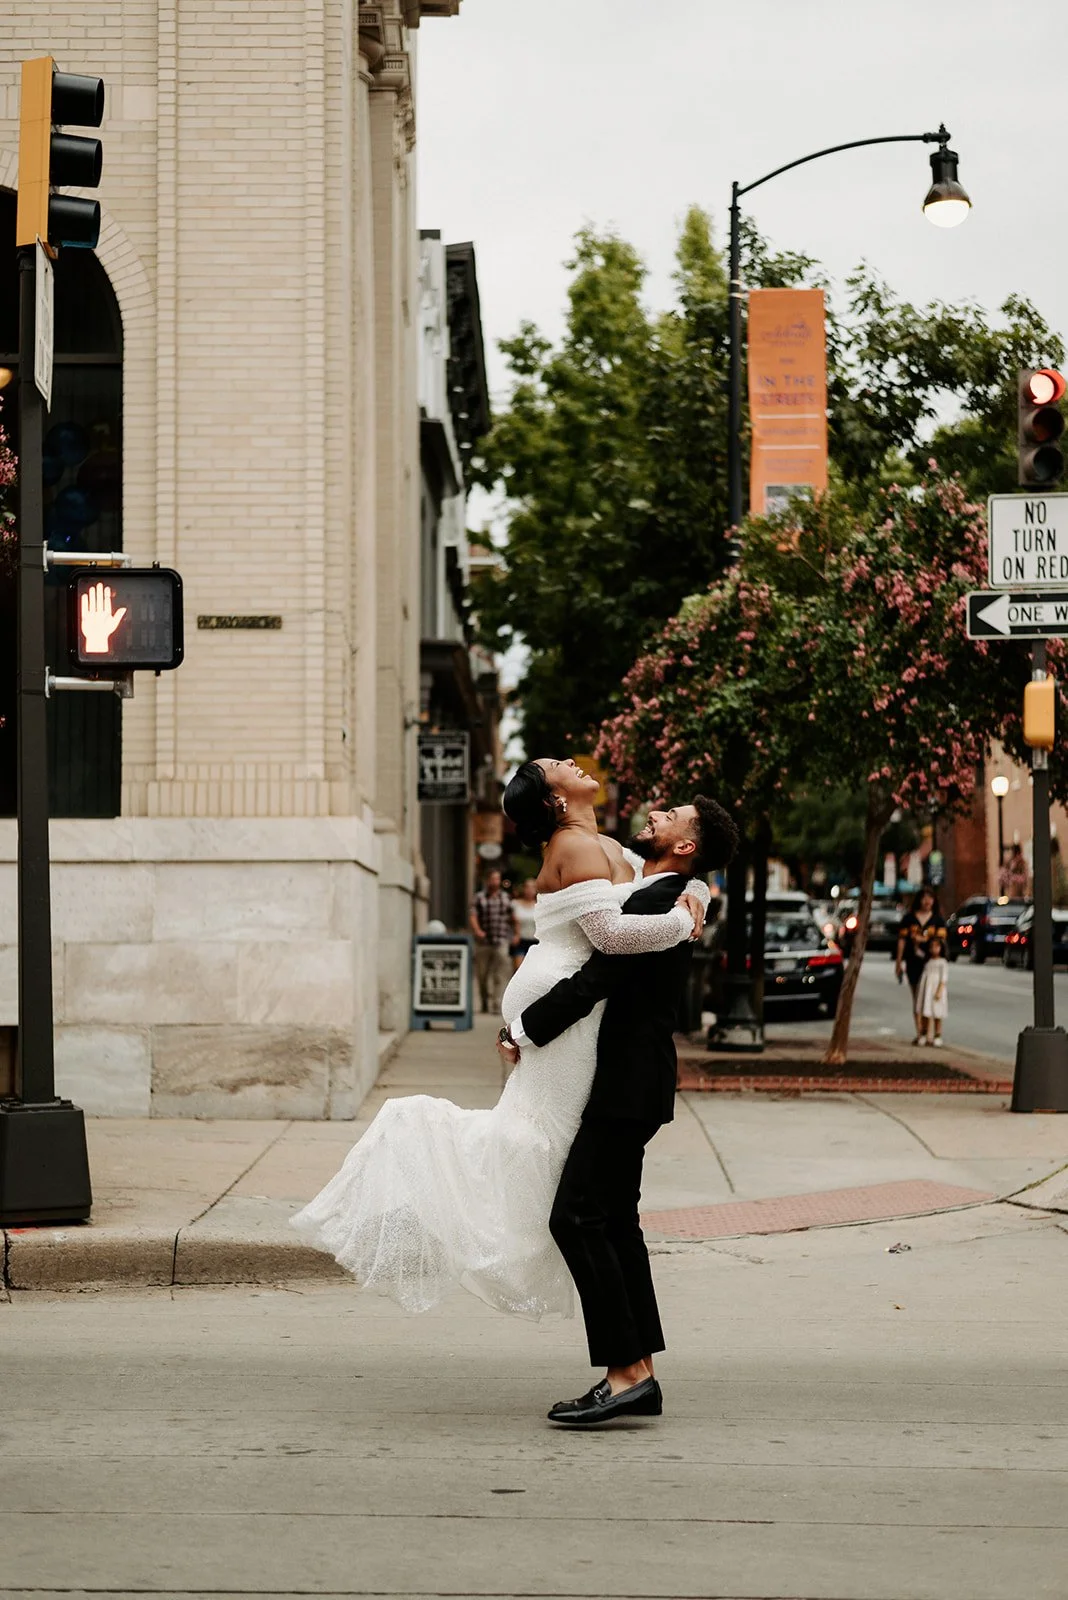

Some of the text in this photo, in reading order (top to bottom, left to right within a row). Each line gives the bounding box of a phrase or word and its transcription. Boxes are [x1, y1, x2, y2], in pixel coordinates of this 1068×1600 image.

[783, 374, 815, 387] THE
[1025, 501, 1046, 524] NO
[1013, 528, 1056, 552] TURN
[1003, 555, 1068, 580] ON RED
[1008, 605, 1043, 622] ONE
